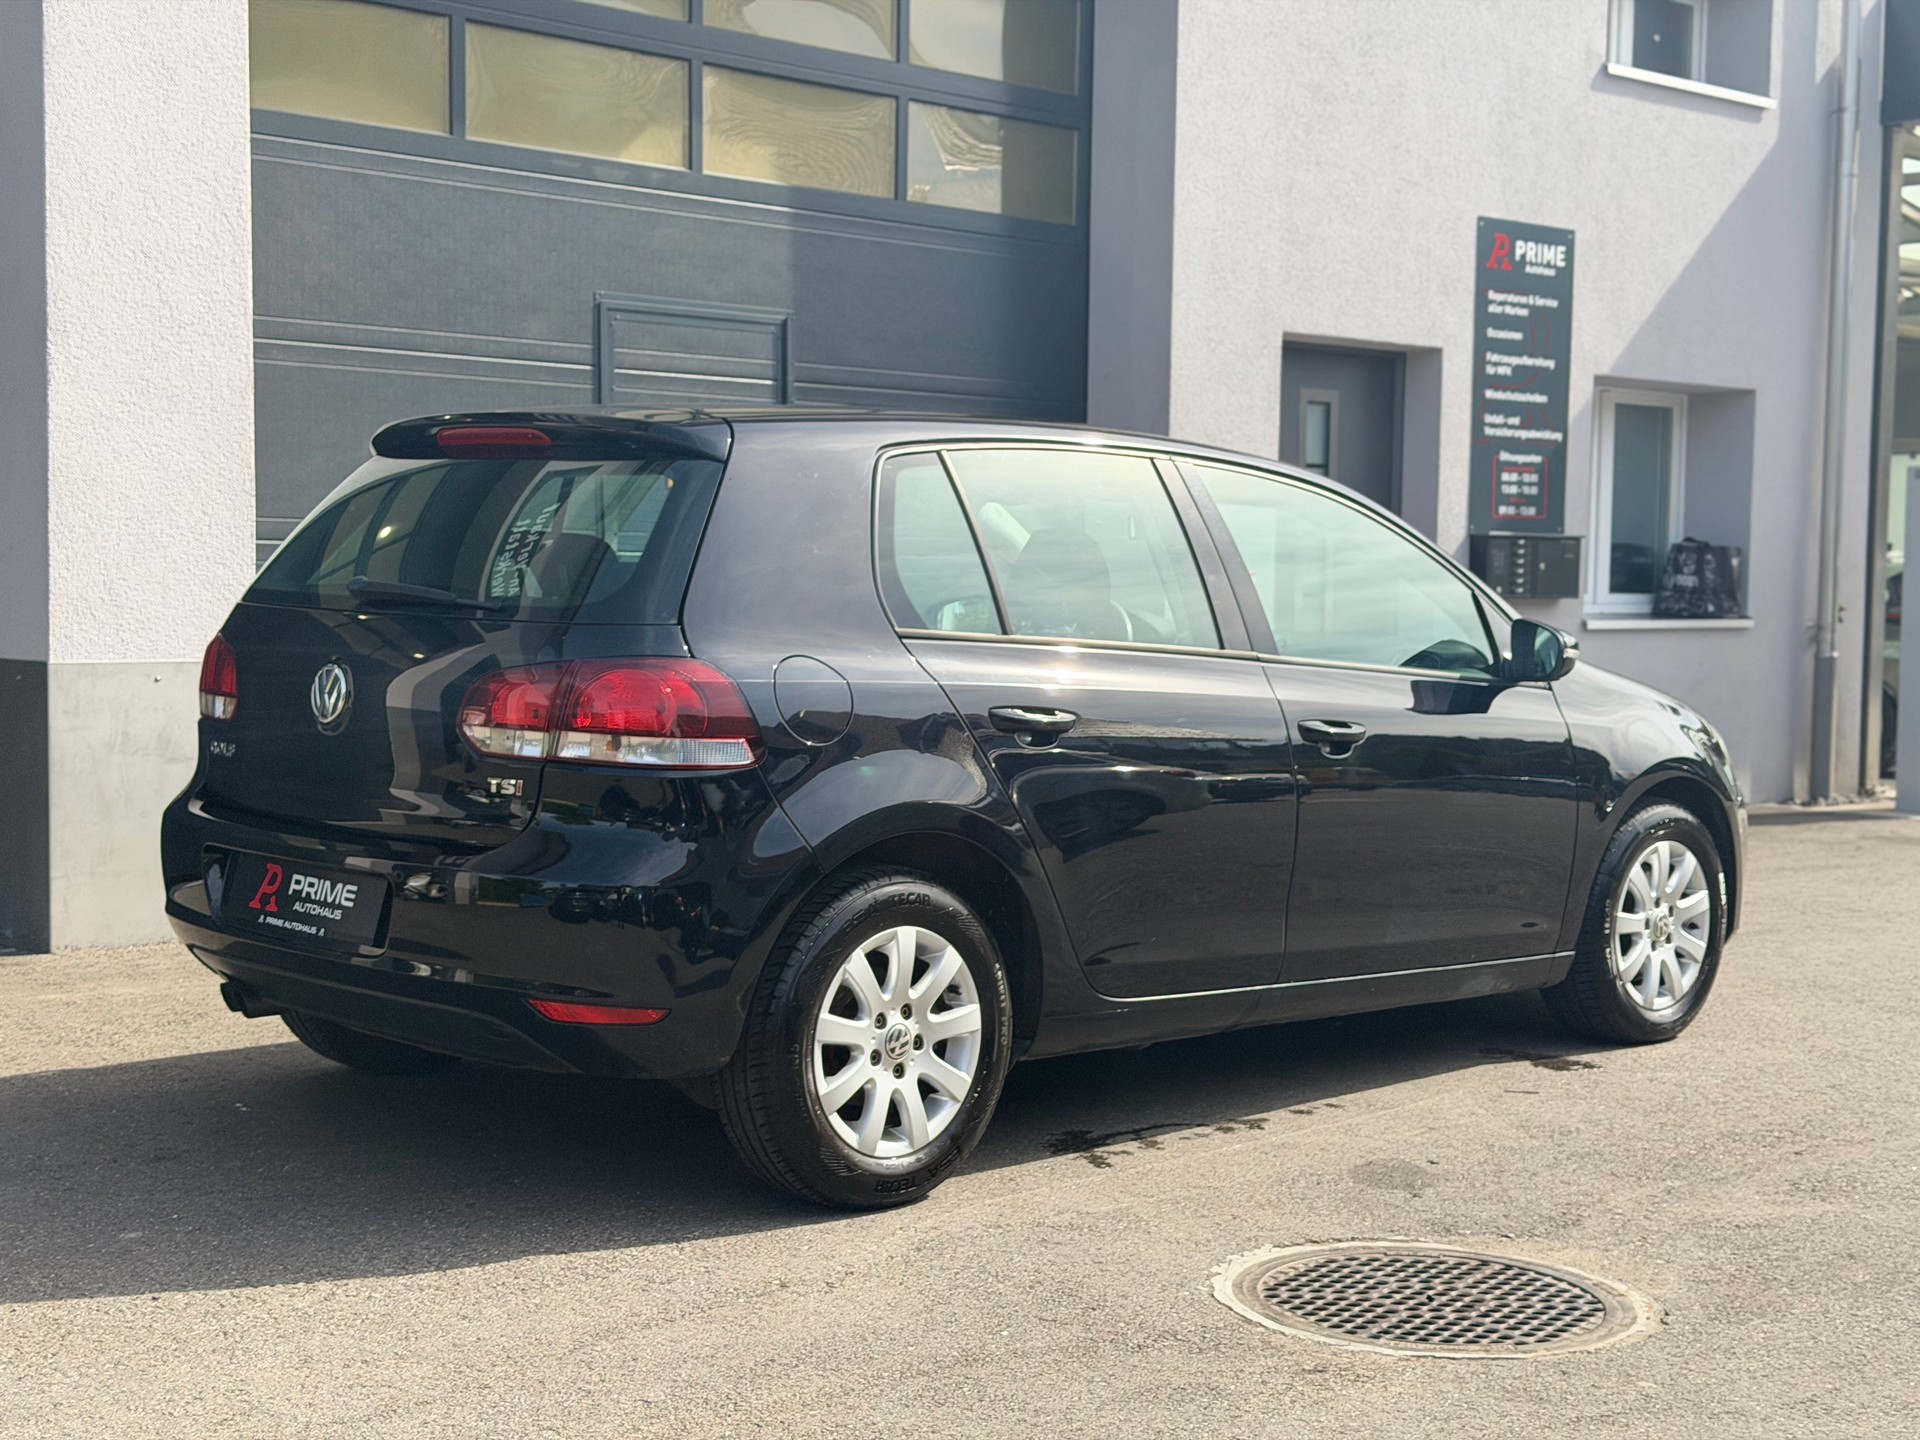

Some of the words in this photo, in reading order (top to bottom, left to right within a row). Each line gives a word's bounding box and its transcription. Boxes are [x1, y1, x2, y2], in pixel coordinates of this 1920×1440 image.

[1515, 240, 1566, 267] PRIME
[487, 777, 524, 796] TSI
[288, 873, 358, 908] PRIME
[292, 901, 343, 920] AUTOHAUS
[265, 916, 285, 927] PRIME
